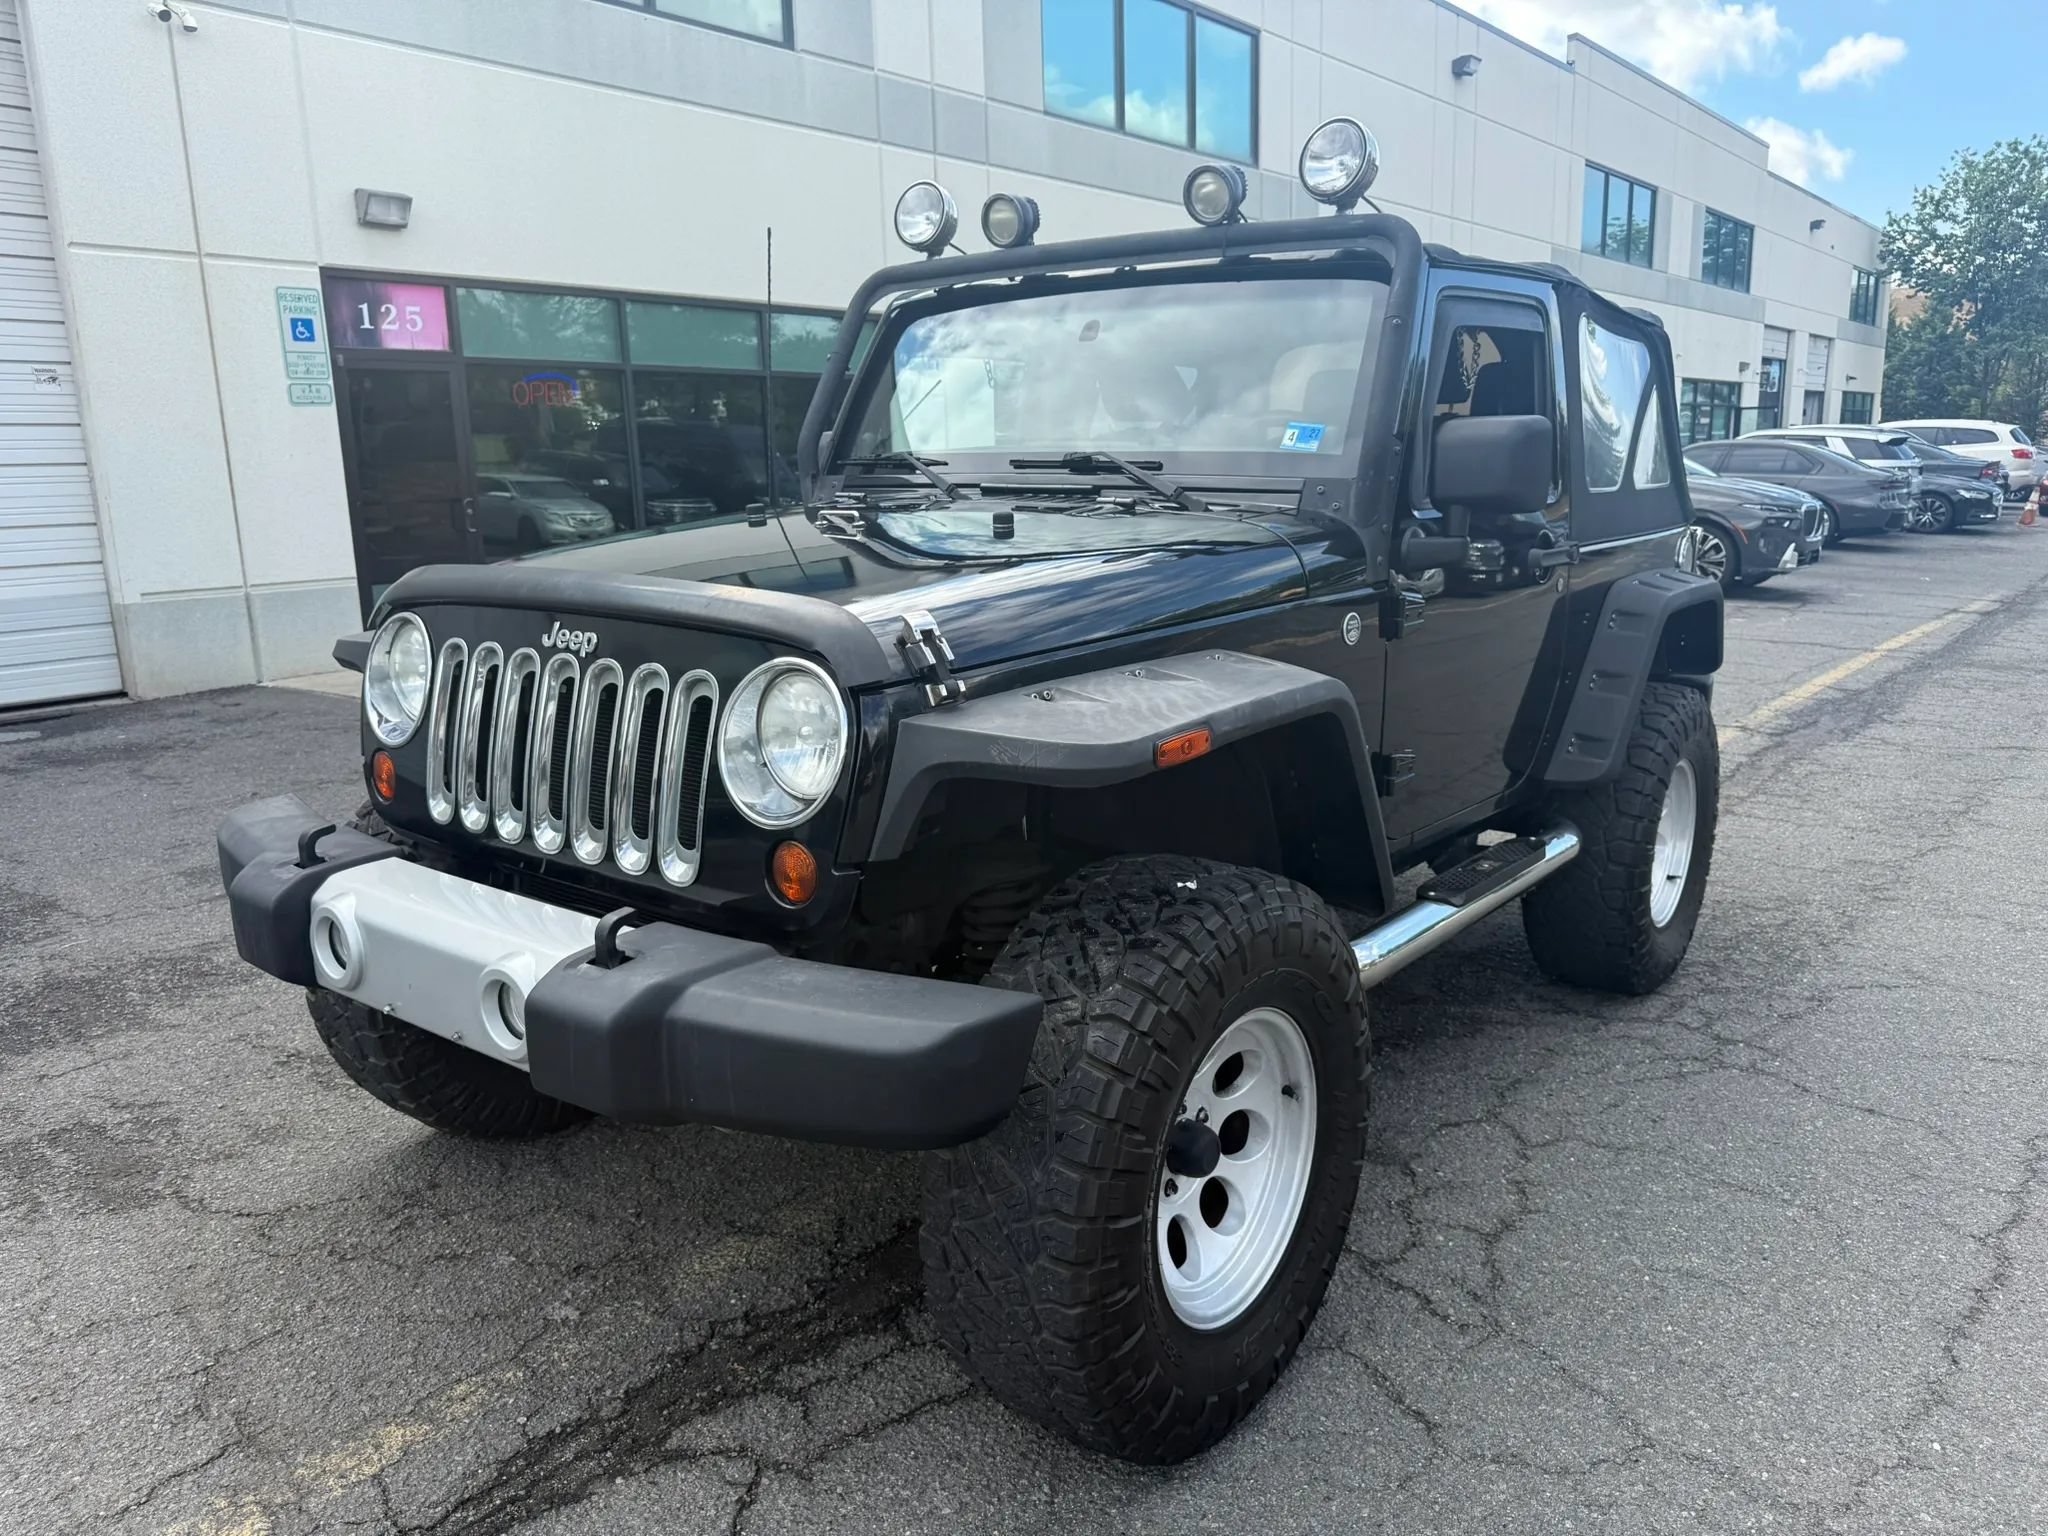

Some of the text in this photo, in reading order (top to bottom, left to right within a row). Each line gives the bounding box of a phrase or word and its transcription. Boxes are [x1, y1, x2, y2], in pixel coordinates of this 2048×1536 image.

[279, 292, 318, 304] RESERVED
[282, 304, 318, 316] PARKING
[358, 302, 424, 331] 125
[512, 381, 576, 406] OPEN
[541, 621, 598, 658] Jeep
